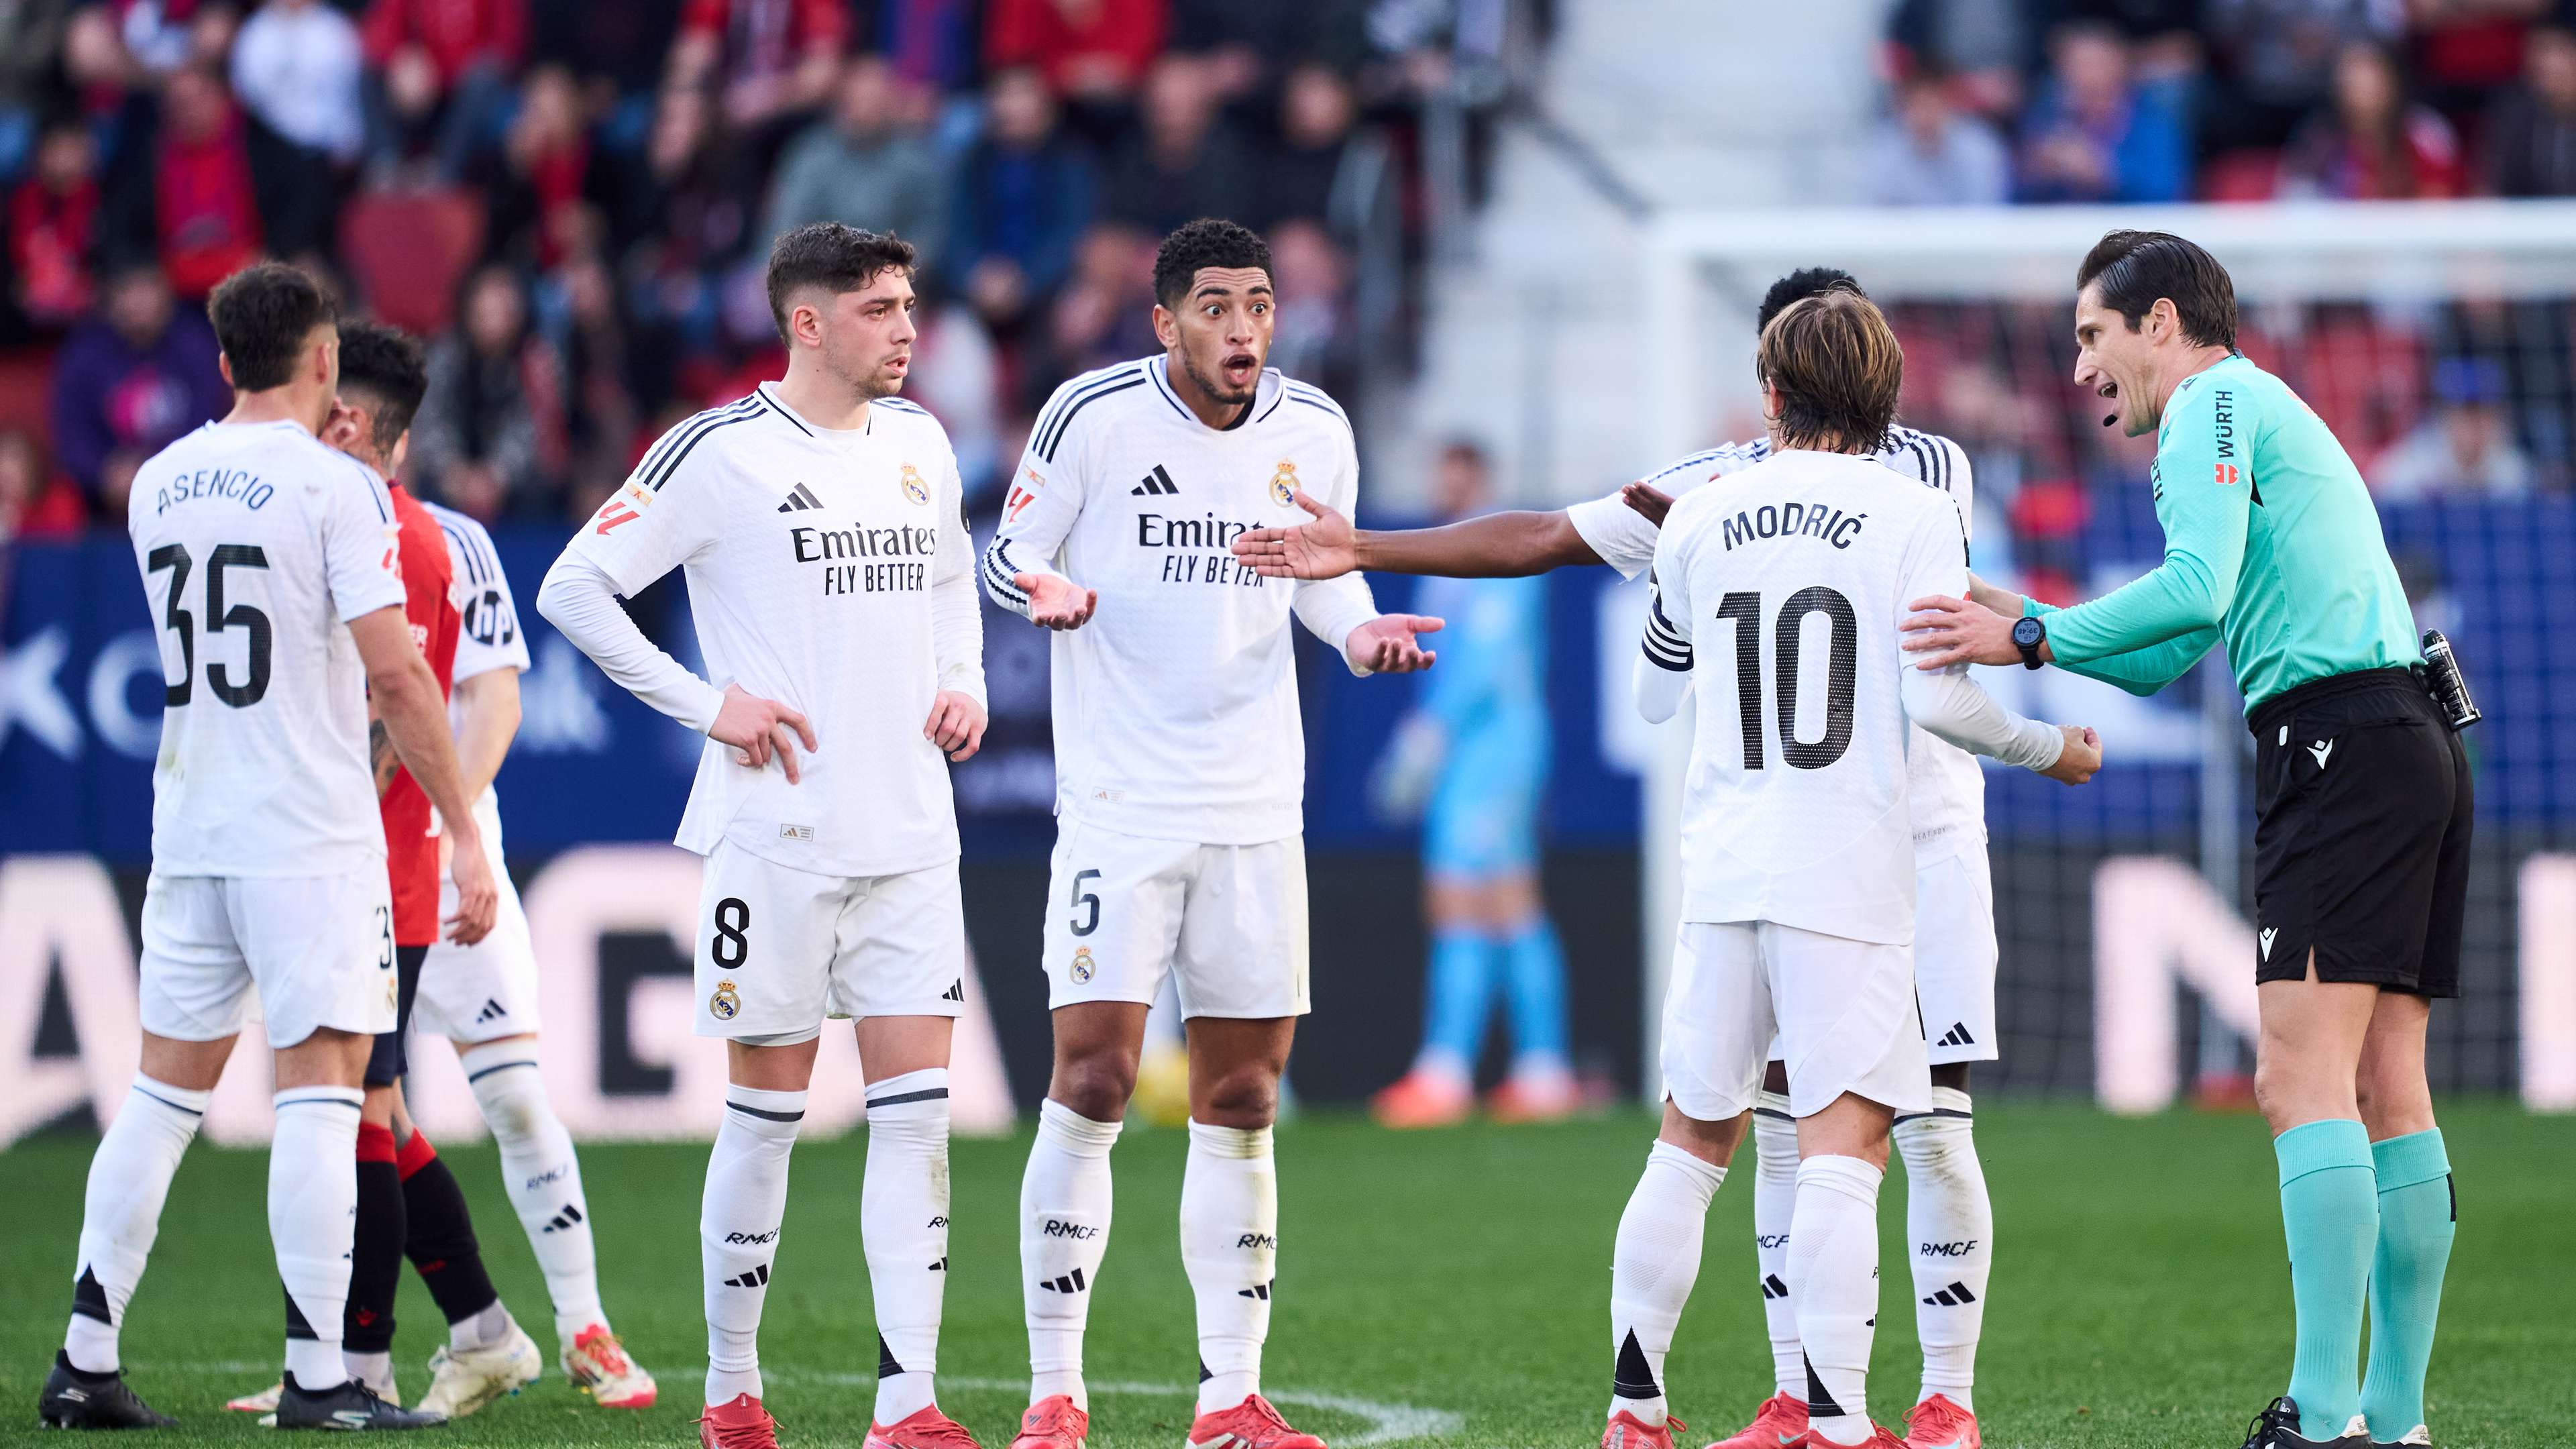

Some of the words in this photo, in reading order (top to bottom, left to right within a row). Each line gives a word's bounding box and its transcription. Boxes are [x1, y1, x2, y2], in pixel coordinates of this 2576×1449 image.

[2216, 390, 2234, 458] WÜRTH
[158, 470, 274, 517] ASENCIO
[790, 522, 936, 563] Emirates
[1722, 502, 1868, 551] MODRIĆ
[825, 567, 856, 595] FLY
[865, 564, 923, 592] BETTER
[1163, 555, 1198, 582] FLY
[149, 543, 272, 709] 35
[1716, 586, 1857, 770] 10
[1070, 869, 1102, 936] 5
[712, 898, 750, 969] 8
[1044, 1220, 1099, 1240] RMCF
[1921, 1240, 1978, 1256] RMCF
